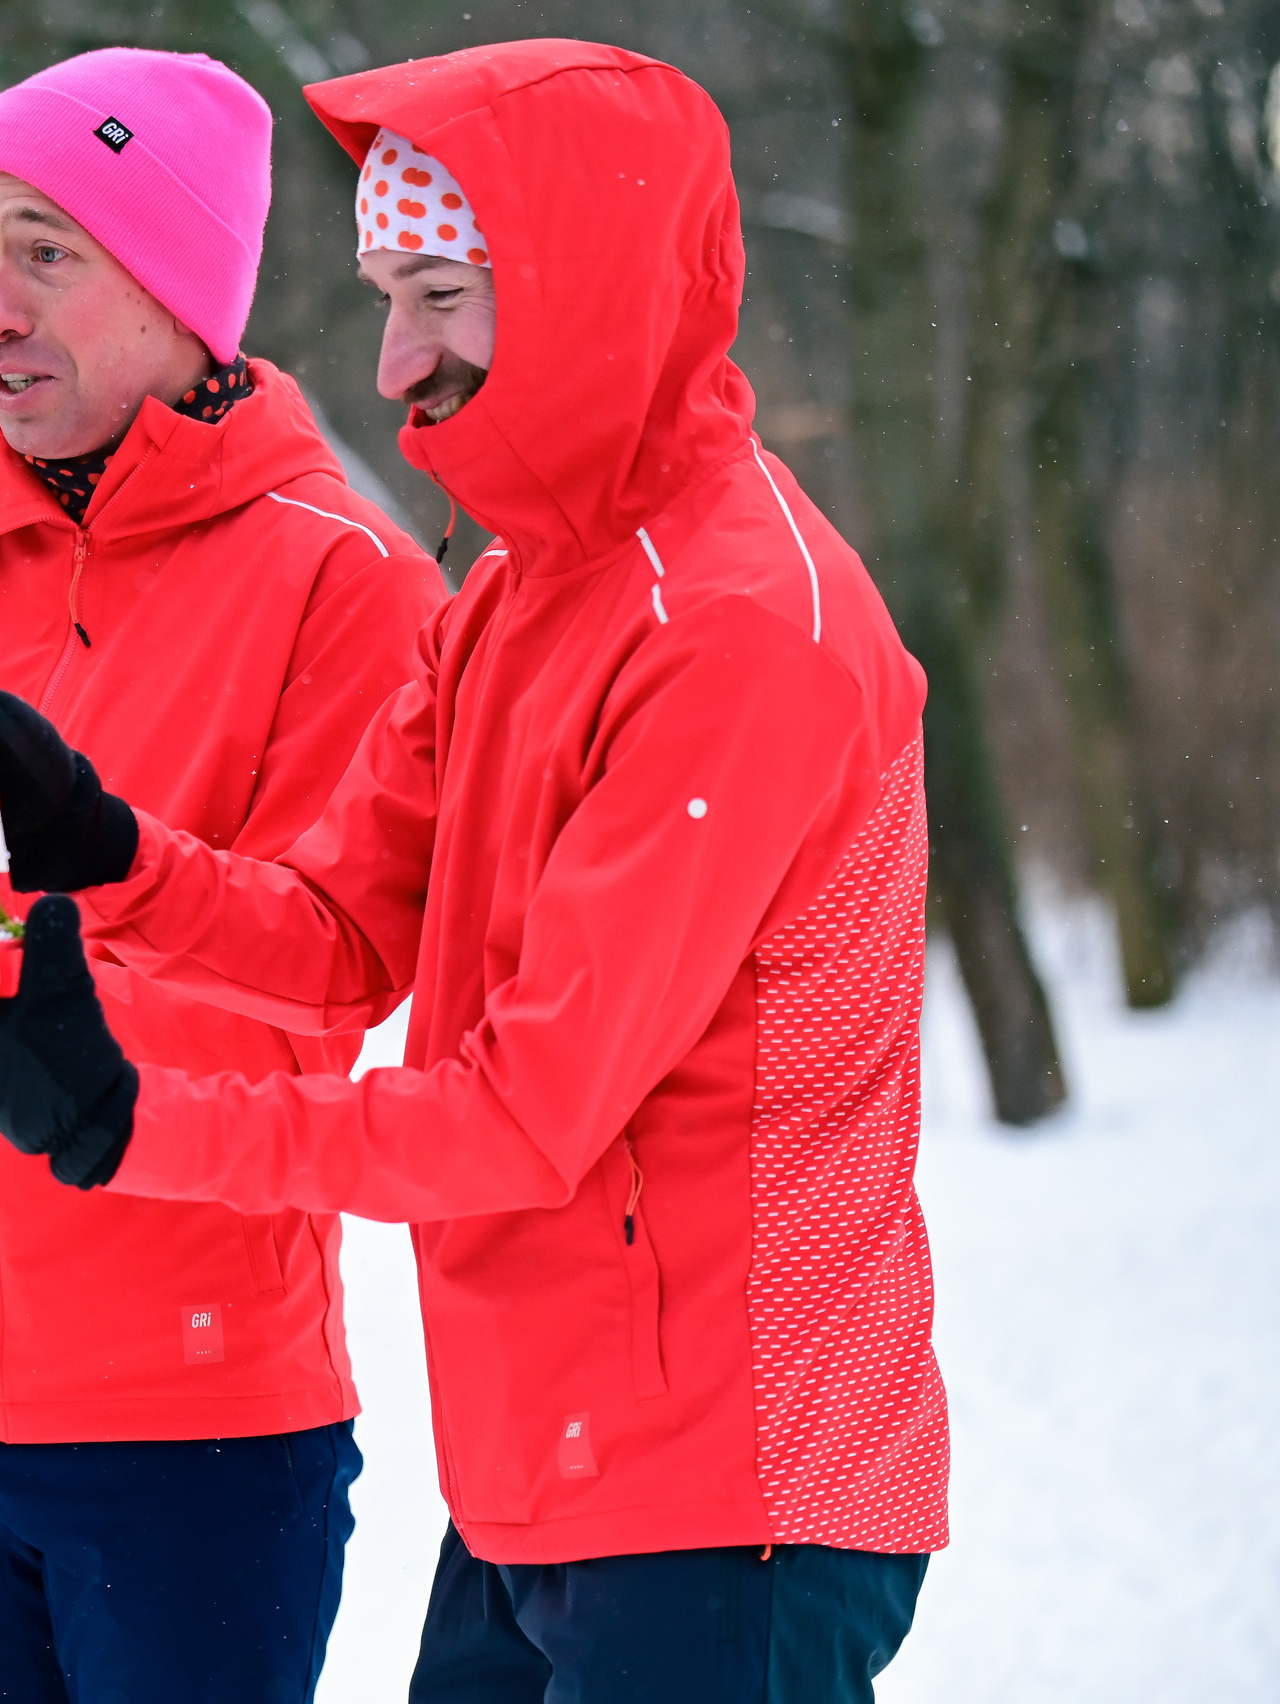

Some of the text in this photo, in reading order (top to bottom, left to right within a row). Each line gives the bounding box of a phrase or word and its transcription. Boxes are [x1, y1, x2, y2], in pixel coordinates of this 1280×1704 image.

[101, 122, 129, 144] GRi
[191, 1312, 212, 1328] GRi
[565, 1421, 583, 1438] GRi
